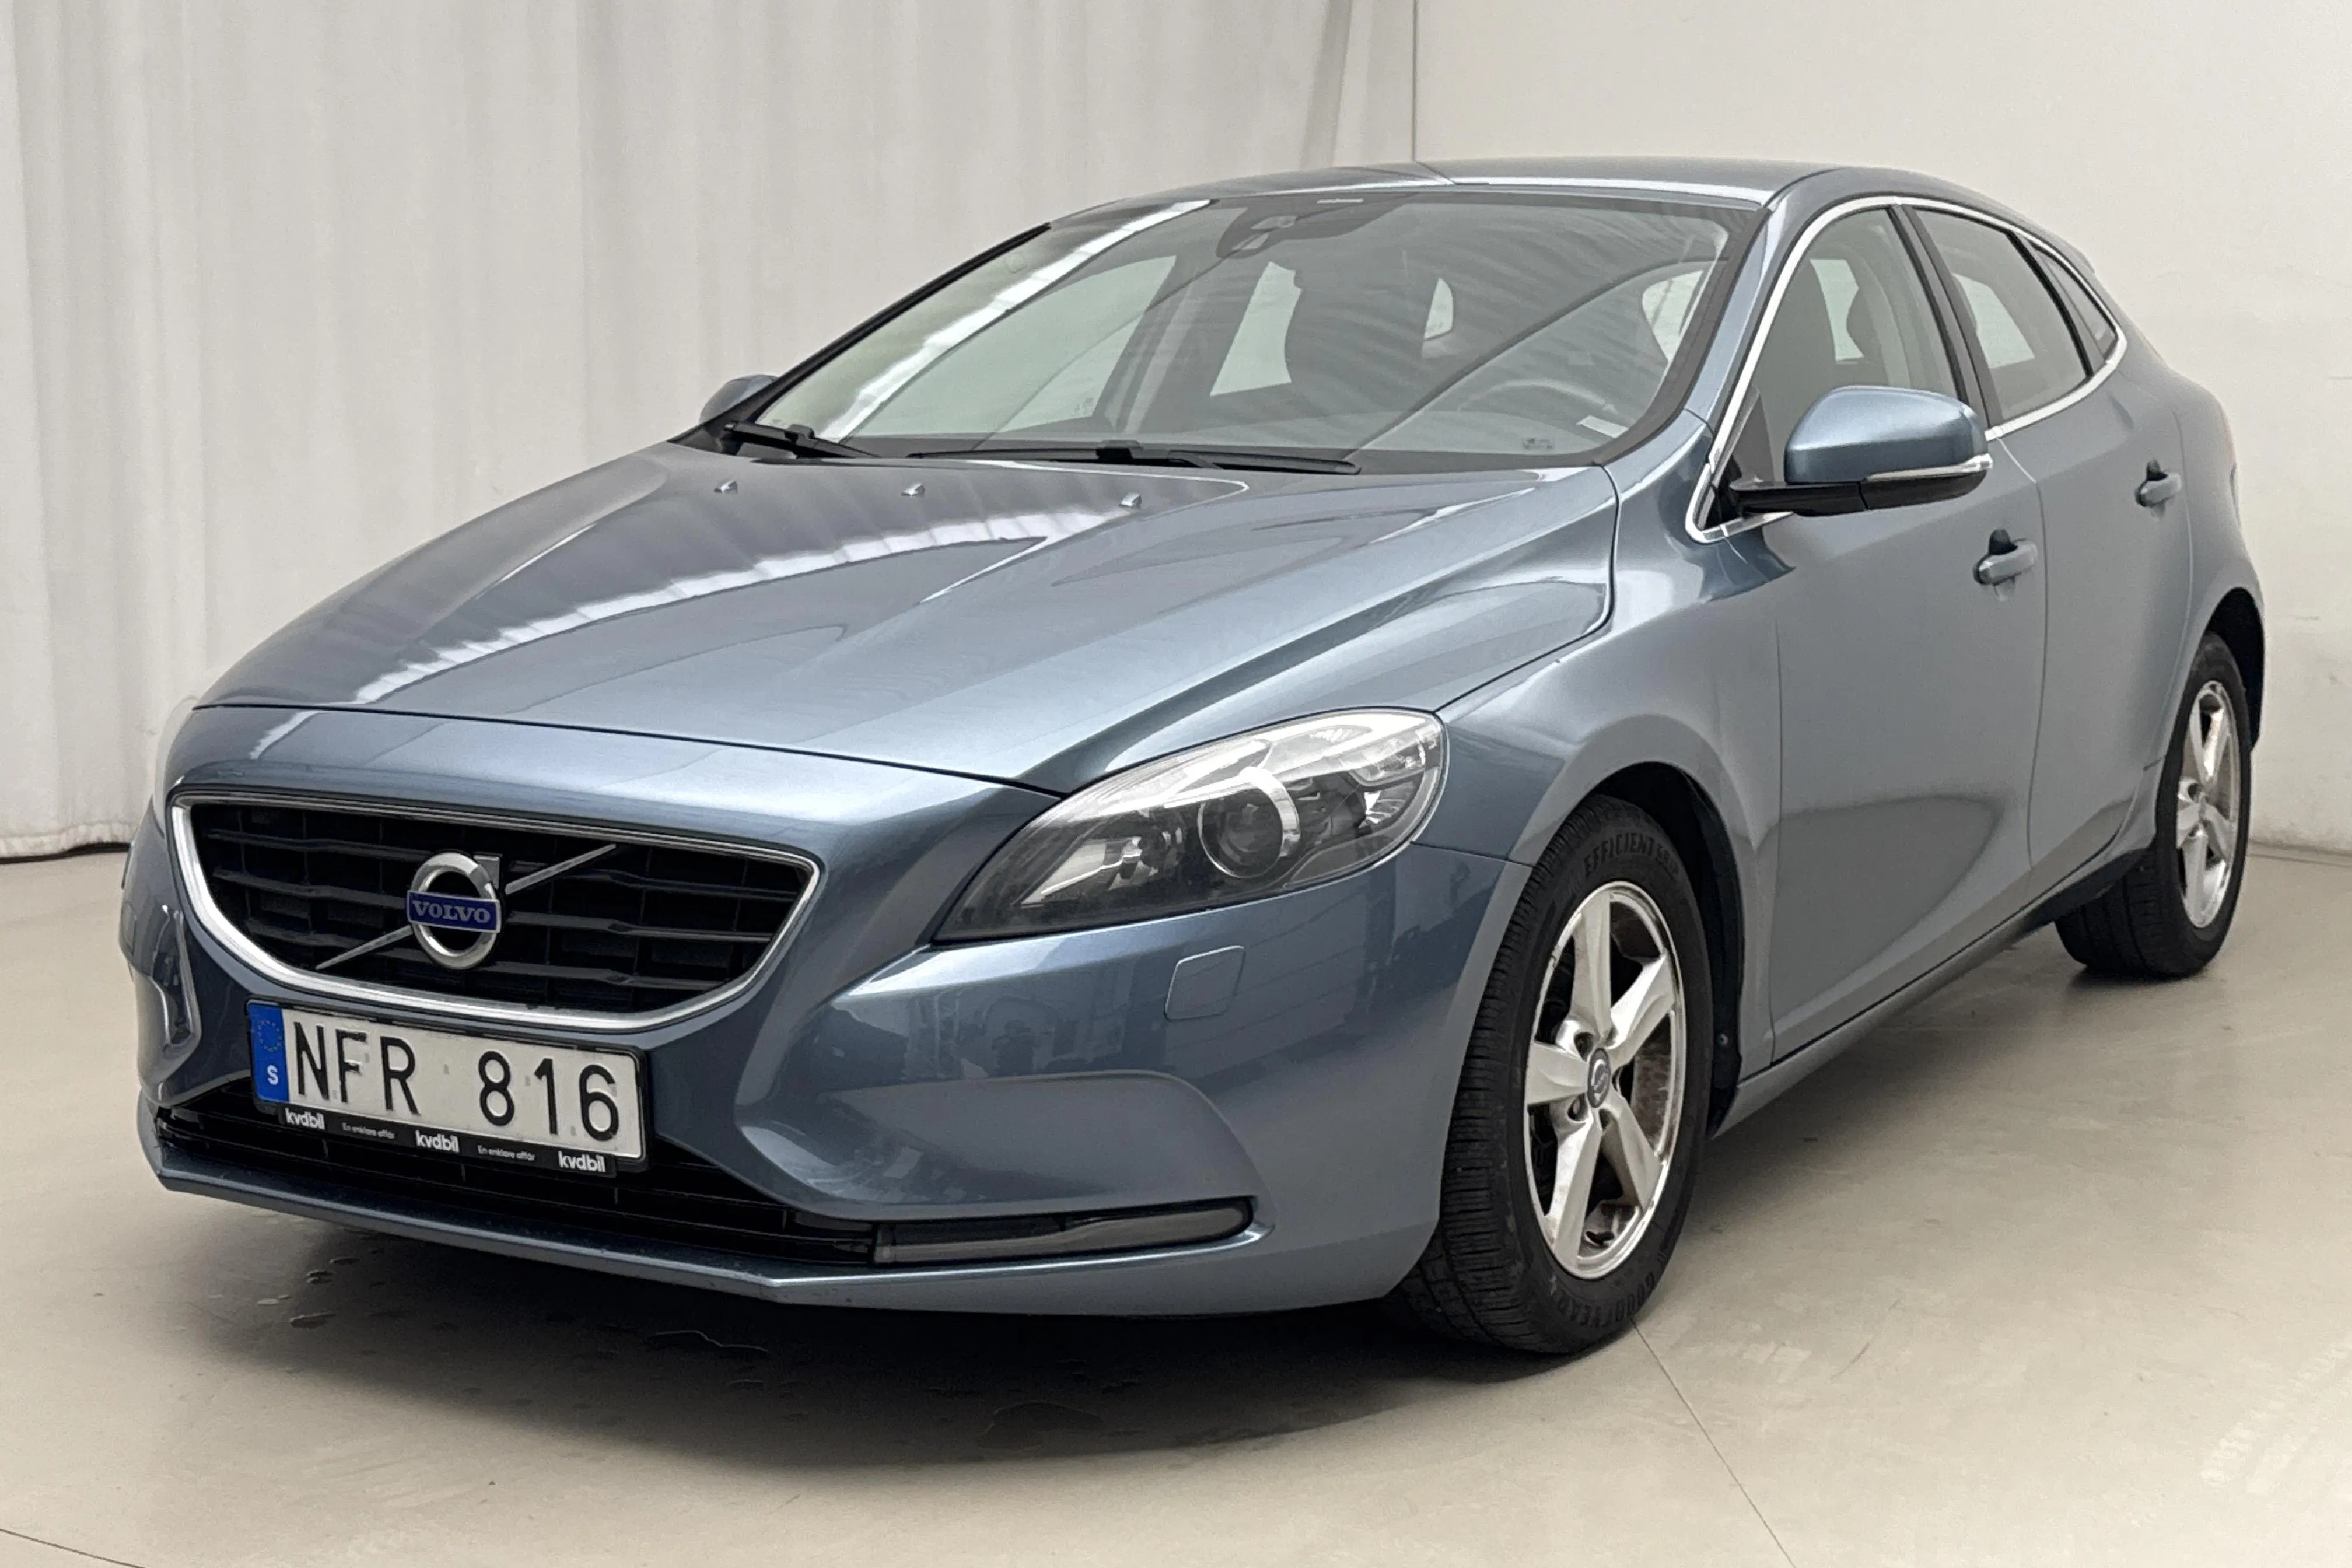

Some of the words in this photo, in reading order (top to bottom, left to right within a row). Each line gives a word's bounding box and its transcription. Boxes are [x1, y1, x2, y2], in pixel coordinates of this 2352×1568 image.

[1583, 832, 1655, 877] EFFICIENT
[412, 900, 491, 923] VOLVO
[267, 1065, 279, 1086] S
[293, 1021, 421, 1117] NFR
[478, 1050, 620, 1142] 816
[285, 1108, 326, 1130] kvdbil
[415, 1129, 460, 1153] kvdbil
[558, 1150, 606, 1174] kvdbil
